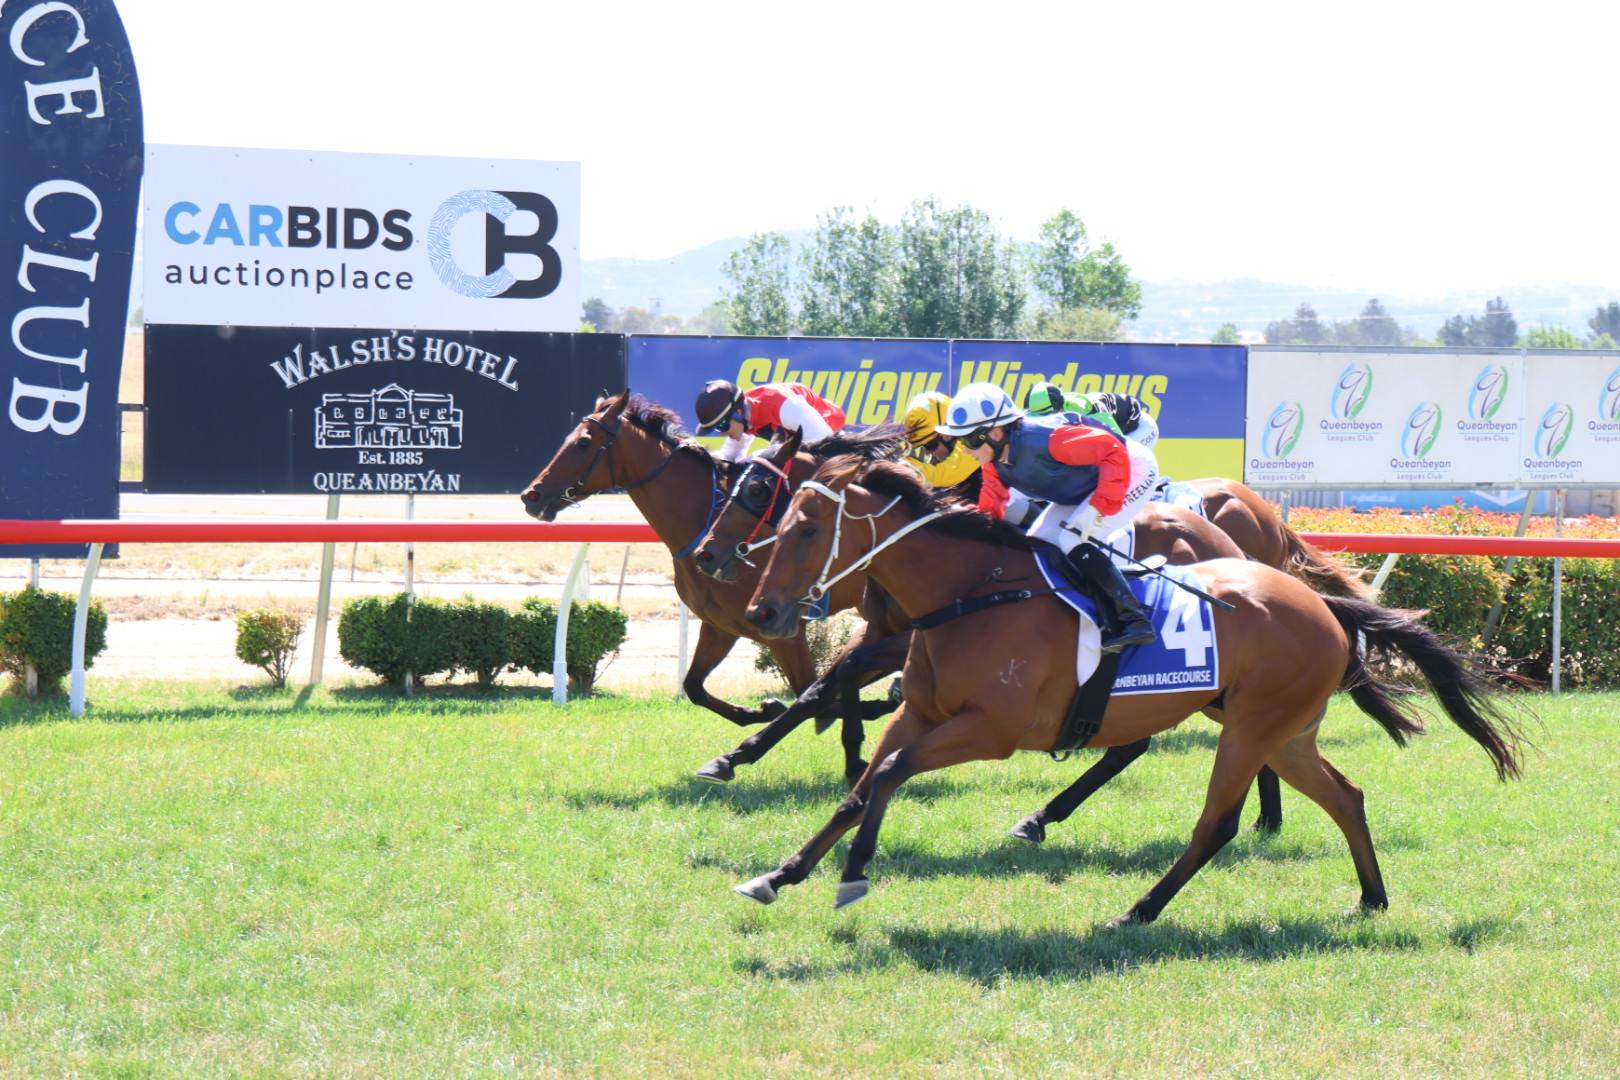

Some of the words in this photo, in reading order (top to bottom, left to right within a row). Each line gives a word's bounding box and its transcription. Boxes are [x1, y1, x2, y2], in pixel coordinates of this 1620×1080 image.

[0, 0, 105, 126] CE
[163, 201, 414, 251] CARBIDS
[164, 261, 414, 294] auctionplace
[8, 179, 103, 437] CLUB
[269, 329, 416, 390] WALSH'S
[422, 336, 519, 392] HOTEL
[1320, 419, 1383, 432] Queanbeyan
[1456, 420, 1518, 432] Queanbeyan
[1588, 420, 1620, 431] Quean
[358, 451, 387, 465] Est.
[388, 451, 424, 465] 1885
[1250, 458, 1315, 471] Queanbeyan
[1389, 458, 1452, 471] Queanbeyan
[1523, 458, 1583, 470] Queanbeyan
[312, 469, 462, 492] QUEANBEYAN
[1160, 583, 1213, 668] 4
[1112, 673, 1156, 688] ANBEYAN
[1155, 670, 1212, 685] RACECOURSE
